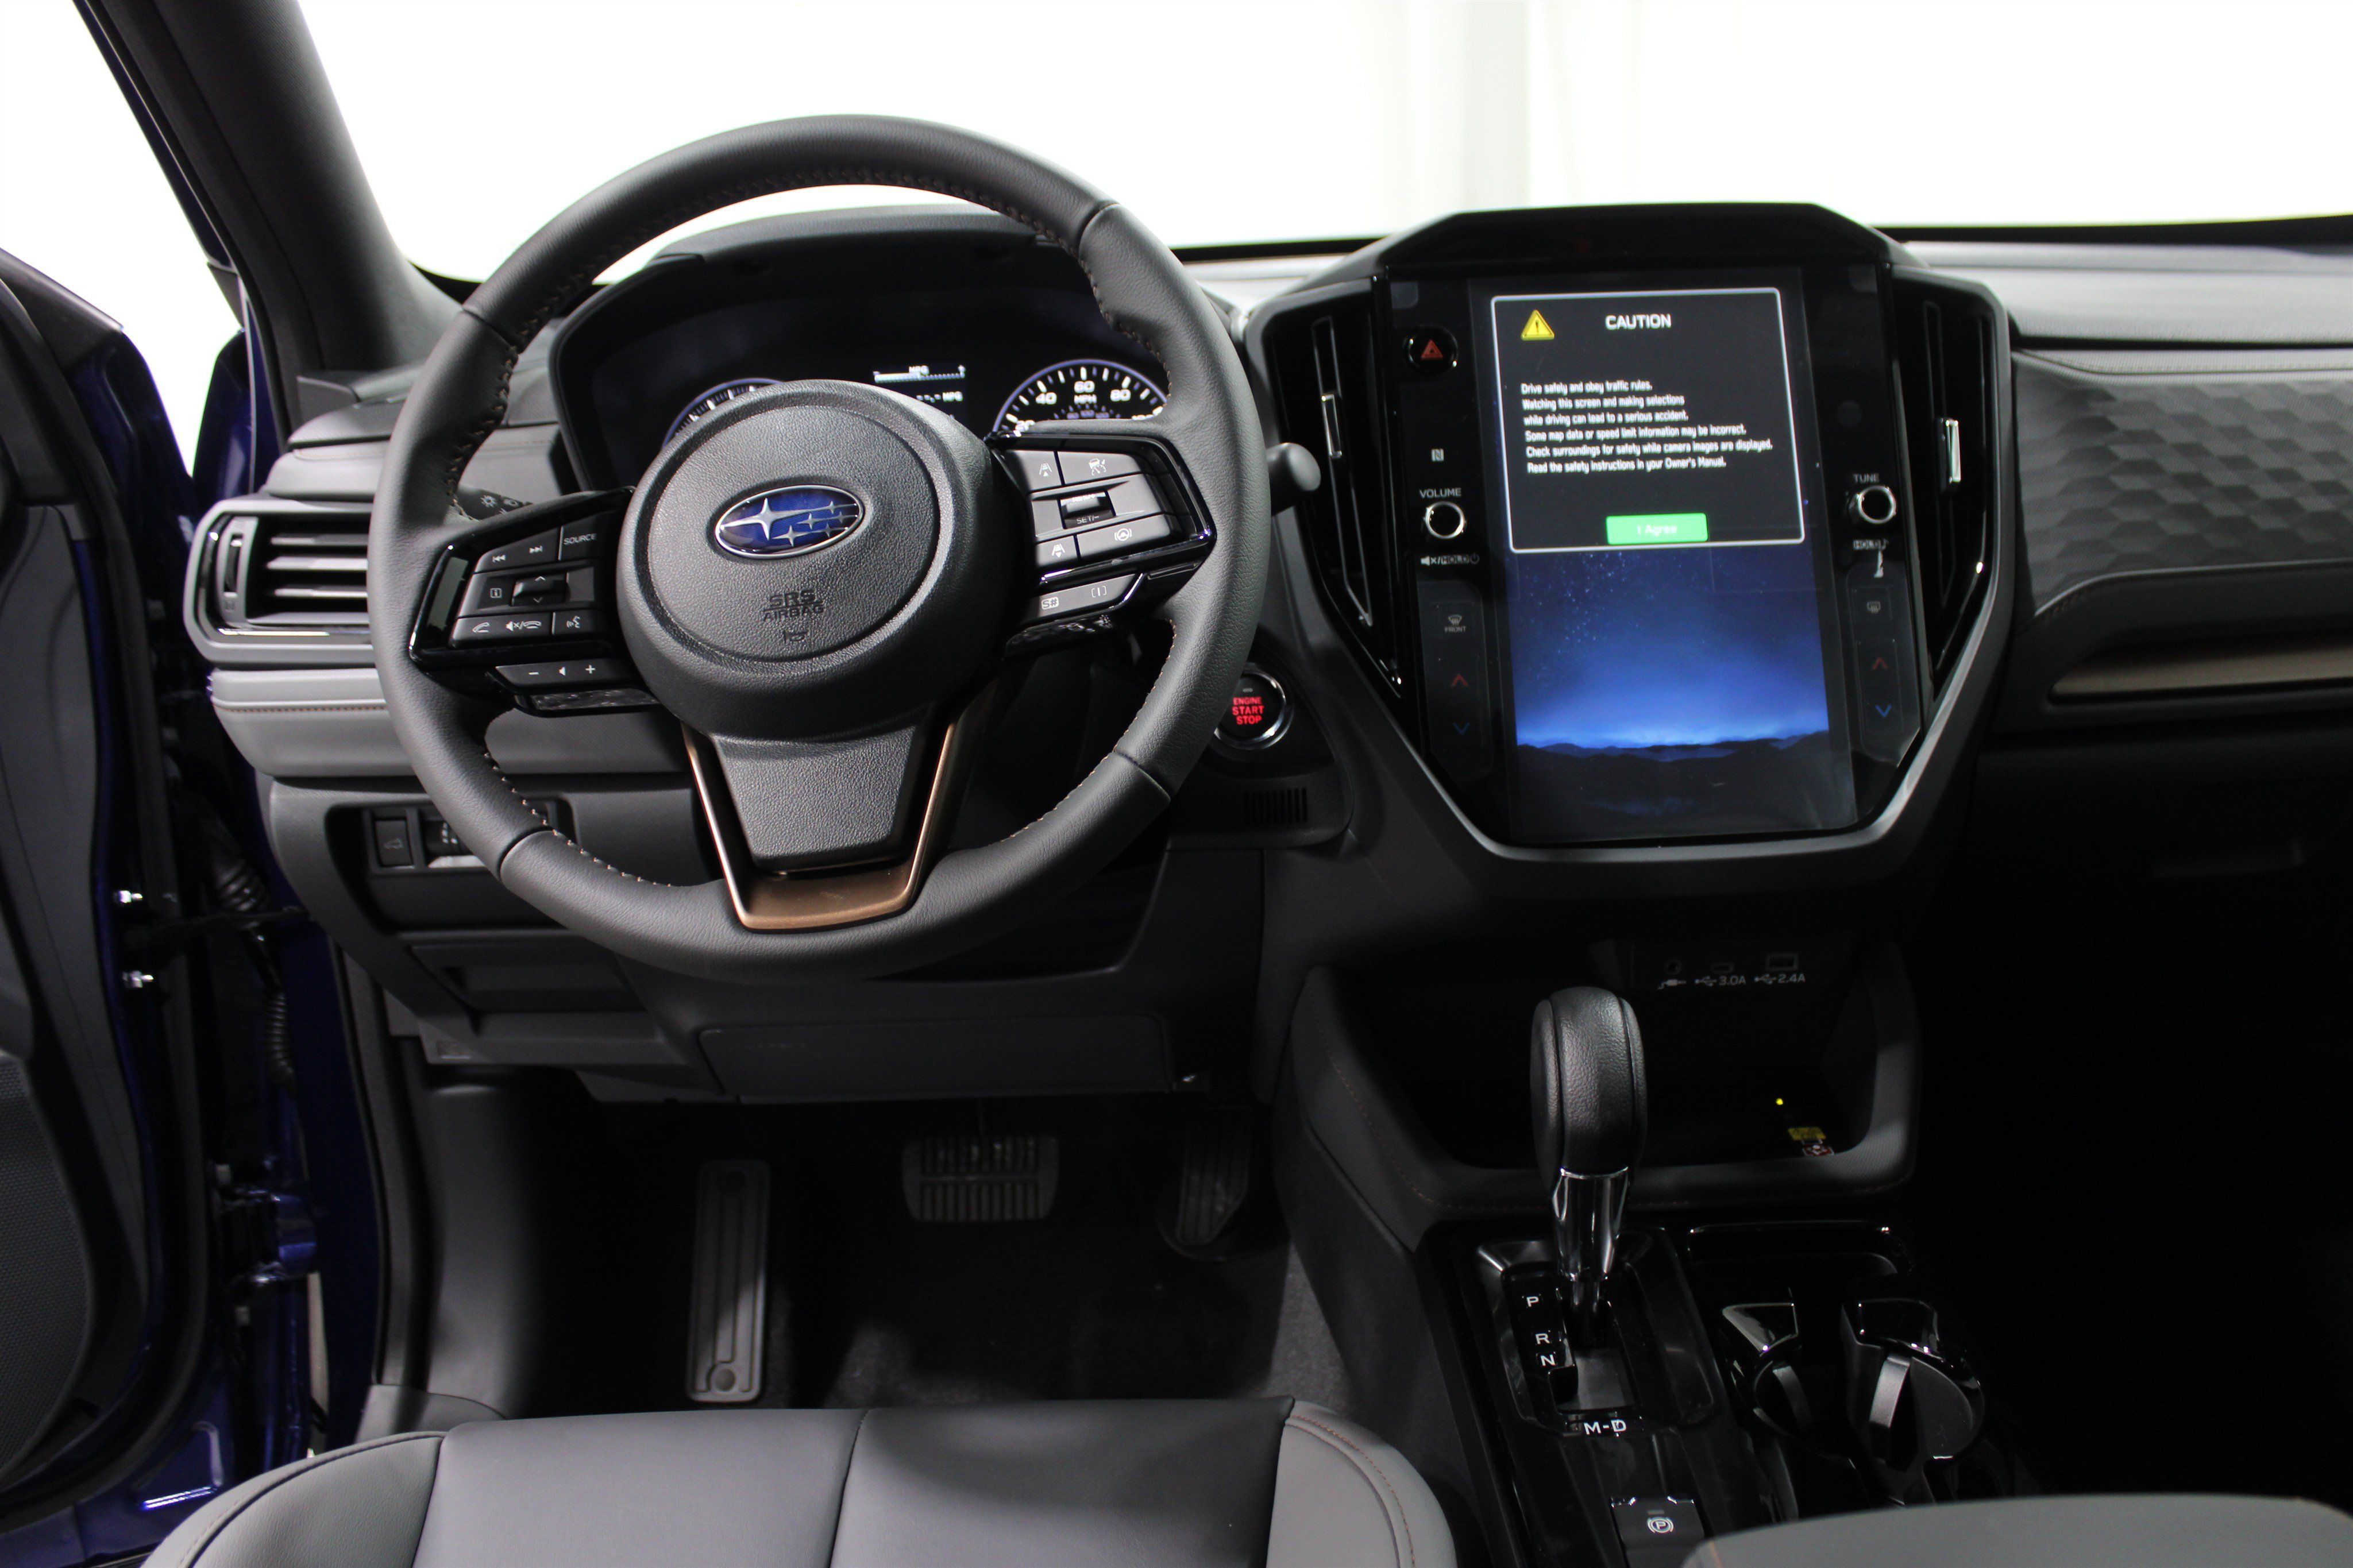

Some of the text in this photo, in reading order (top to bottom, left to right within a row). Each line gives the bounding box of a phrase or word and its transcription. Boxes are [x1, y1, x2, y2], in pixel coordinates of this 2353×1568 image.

[1605, 314, 1672, 330] CAUTION
[1074, 380, 1095, 393] 60
[1521, 379, 1652, 395] Drive safely and obey traffic rules.
[1035, 392, 1057, 405] 40
[1074, 394, 1097, 405] MPH
[1110, 389, 1132, 402] 80
[1522, 394, 1685, 412] Watching this screen and making selections
[1523, 410, 1688, 427] while driving can lead to a serious accident.
[1525, 423, 1746, 442] Some map data or speed limit information may be incorrect.
[1526, 438, 1772, 458] Check surroundings for safety while camera images are displayed.
[1527, 456, 1726, 474] Read the safety instructions in your Owner's Manual.
[1853, 473, 1880, 483] TUNE
[1419, 488, 1461, 499] VOLUME
[1637, 524, 1677, 536] I Agree
[564, 533, 597, 545] SOURCE
[769, 588, 816, 607] SRS
[762, 600, 826, 621] AIRBAG
[1233, 696, 1262, 705] ENGINE
[1232, 705, 1264, 716] START
[1236, 715, 1262, 725] STOP
[1719, 976, 1746, 986] 3.0A
[1778, 974, 1806, 983] 2.4A
[1526, 1296, 1540, 1307] P
[1535, 1333, 1550, 1345] R
[1540, 1354, 1556, 1366] N
